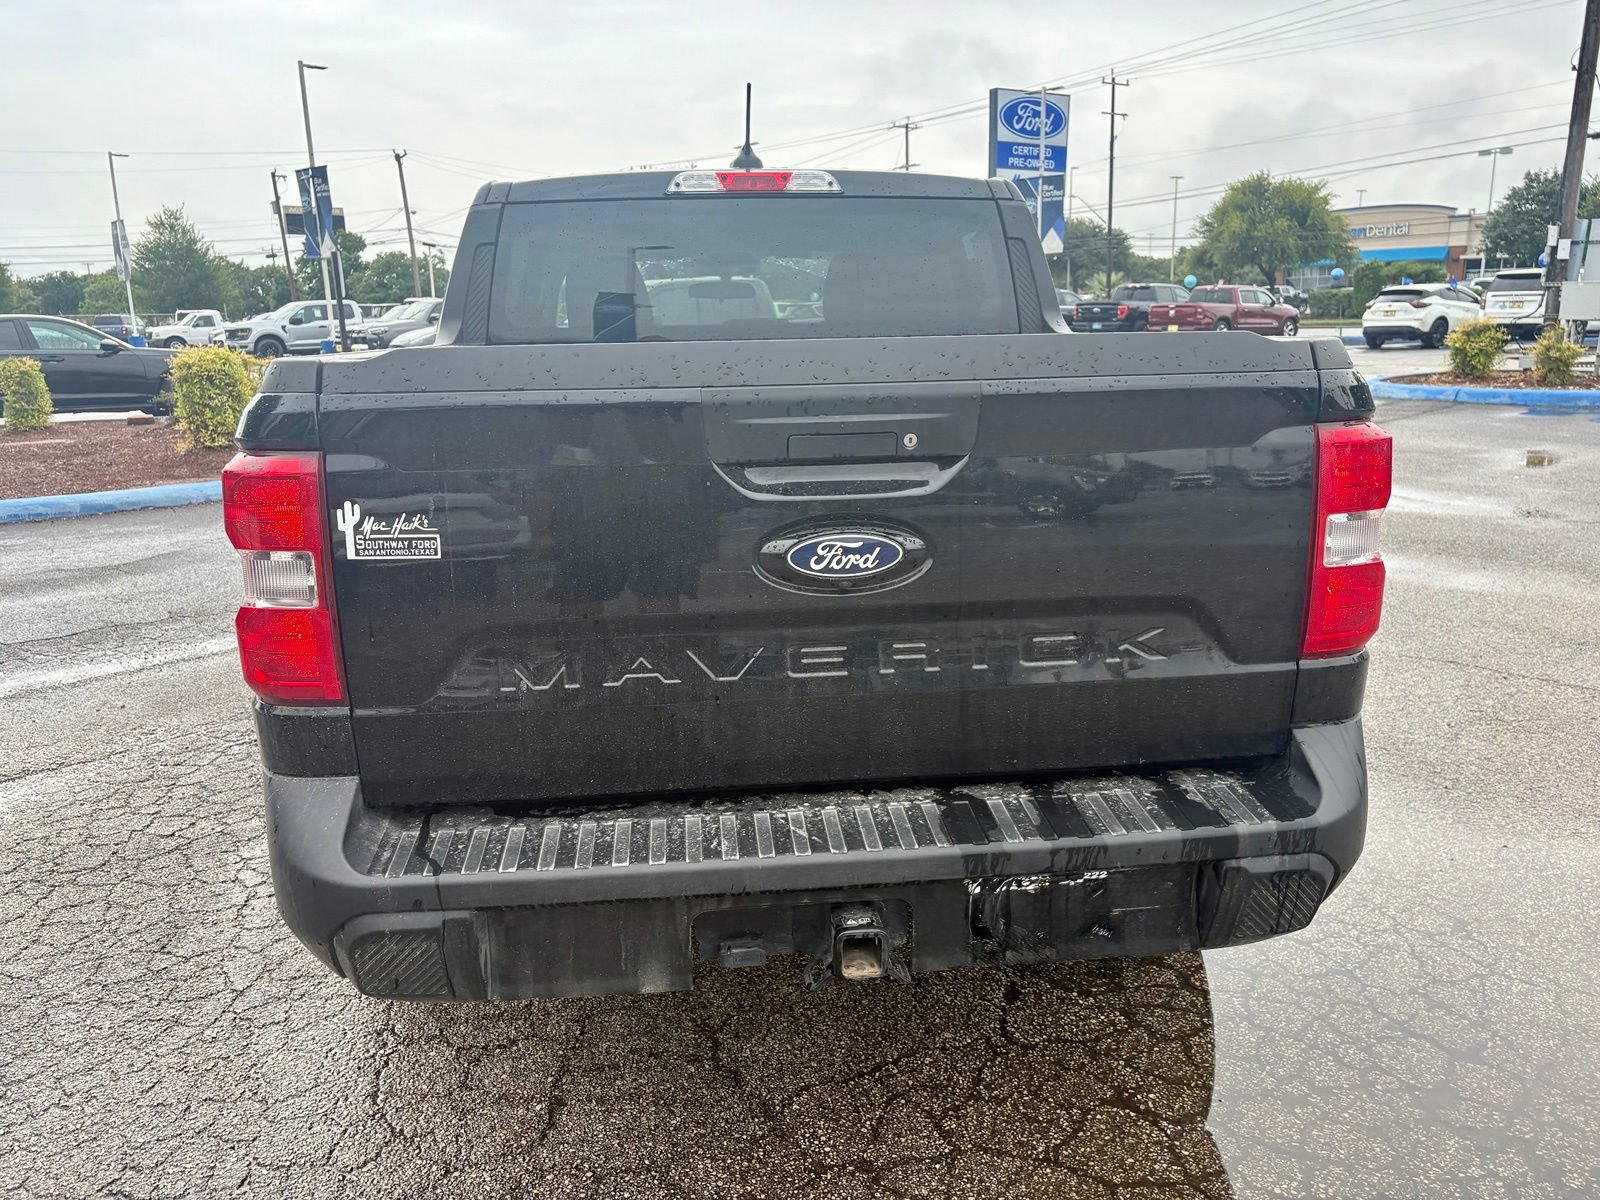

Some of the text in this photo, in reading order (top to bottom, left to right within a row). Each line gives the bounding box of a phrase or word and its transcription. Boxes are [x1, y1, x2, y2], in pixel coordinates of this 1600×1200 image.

[1013, 102, 1055, 133] Ford
[1012, 145, 1053, 157] CERTIFED
[1008, 157, 1055, 169] PRE-OWED
[359, 516, 391, 539] Mac
[356, 535, 437, 549] SOUTHWAY FORD
[810, 541, 881, 570] Ford
[499, 627, 1168, 692] MAVERICK
